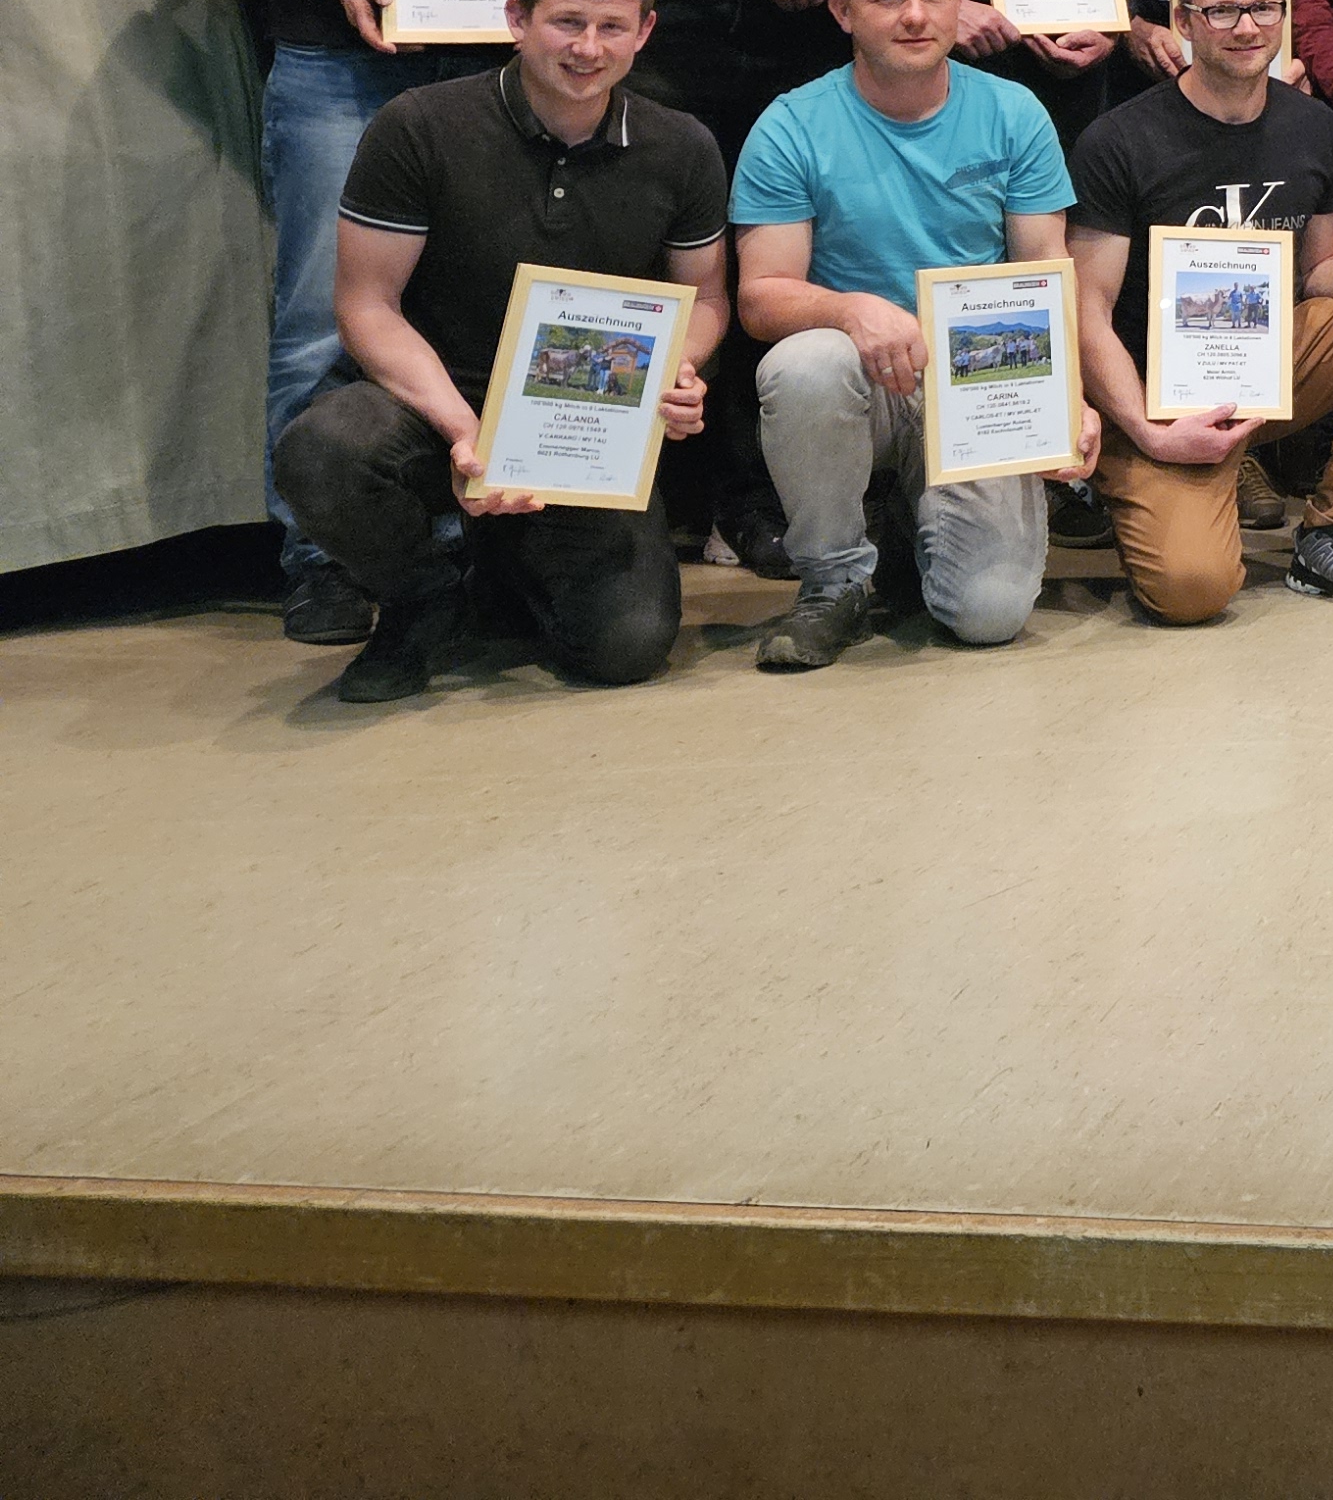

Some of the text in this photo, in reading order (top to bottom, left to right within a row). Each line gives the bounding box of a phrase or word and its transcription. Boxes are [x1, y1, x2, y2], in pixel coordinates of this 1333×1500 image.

[1189, 260, 1257, 271] Auszeichnung
[962, 299, 1035, 312] Auszeichnung
[558, 311, 643, 331] Auszeichnung
[987, 392, 1019, 401] CARINA
[554, 414, 600, 424] CALANDA
